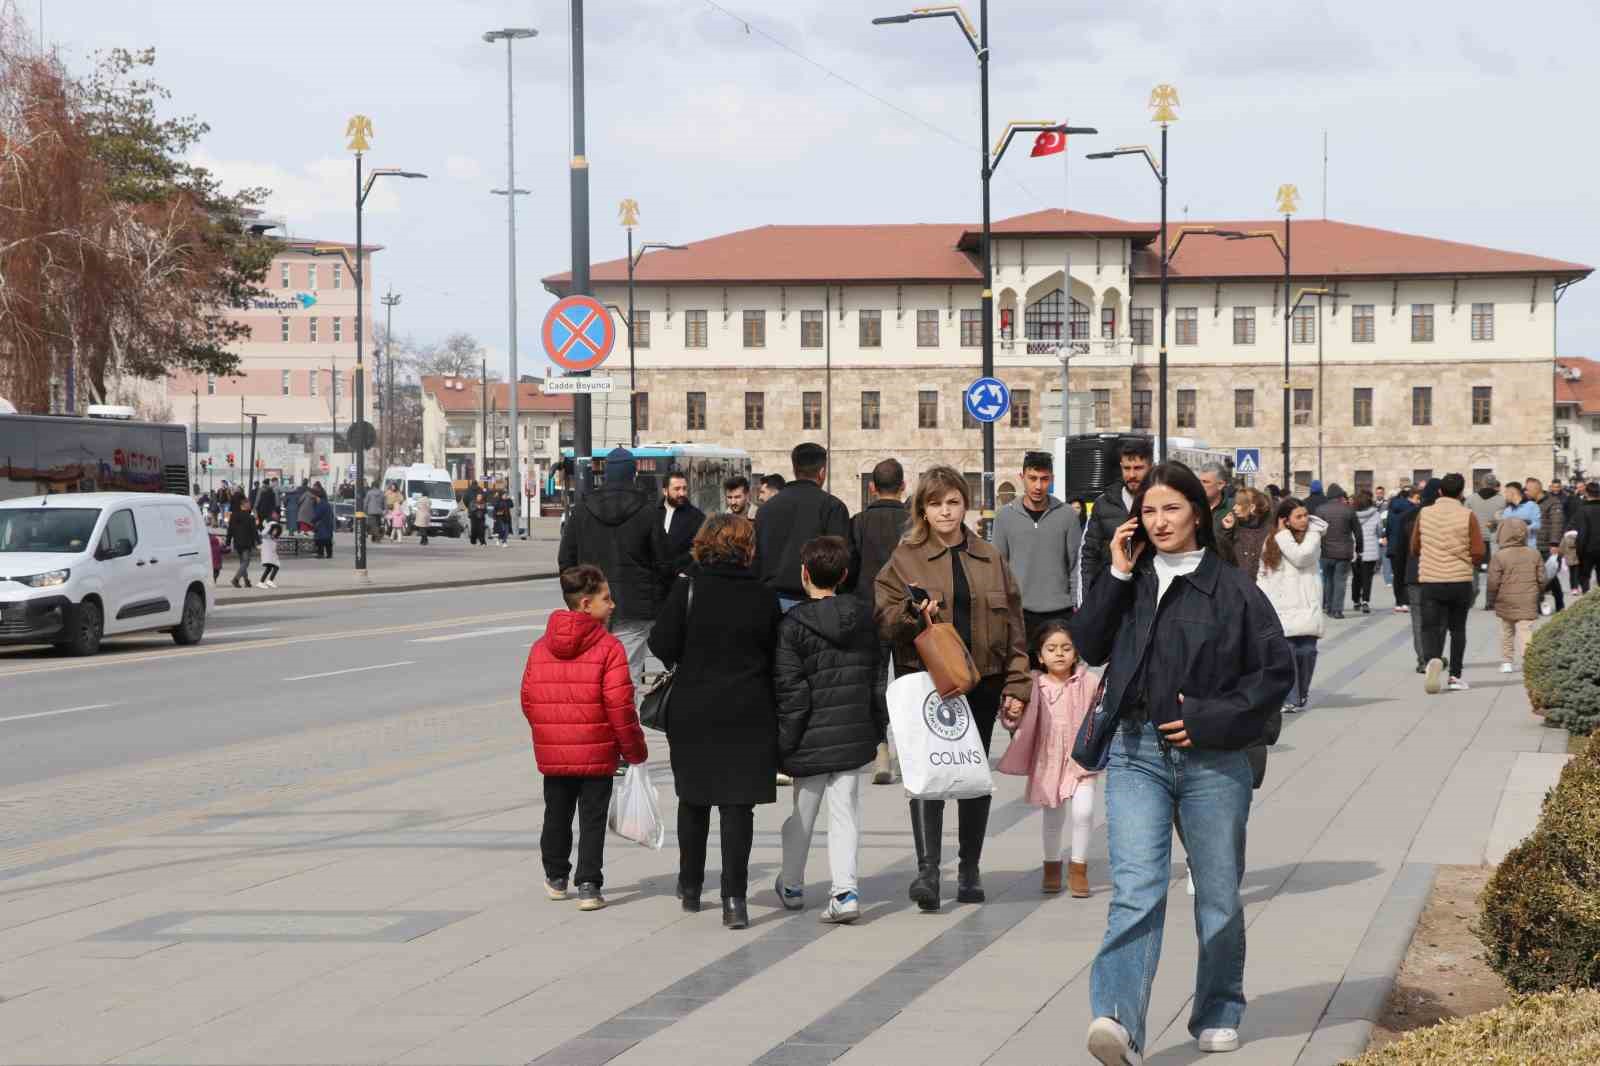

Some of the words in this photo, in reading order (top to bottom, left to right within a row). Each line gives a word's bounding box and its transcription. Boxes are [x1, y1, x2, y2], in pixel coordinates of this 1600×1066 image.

[254, 299, 297, 309] Telekom
[576, 383, 610, 391] Boyunca
[929, 749, 982, 766] COLIN'S
